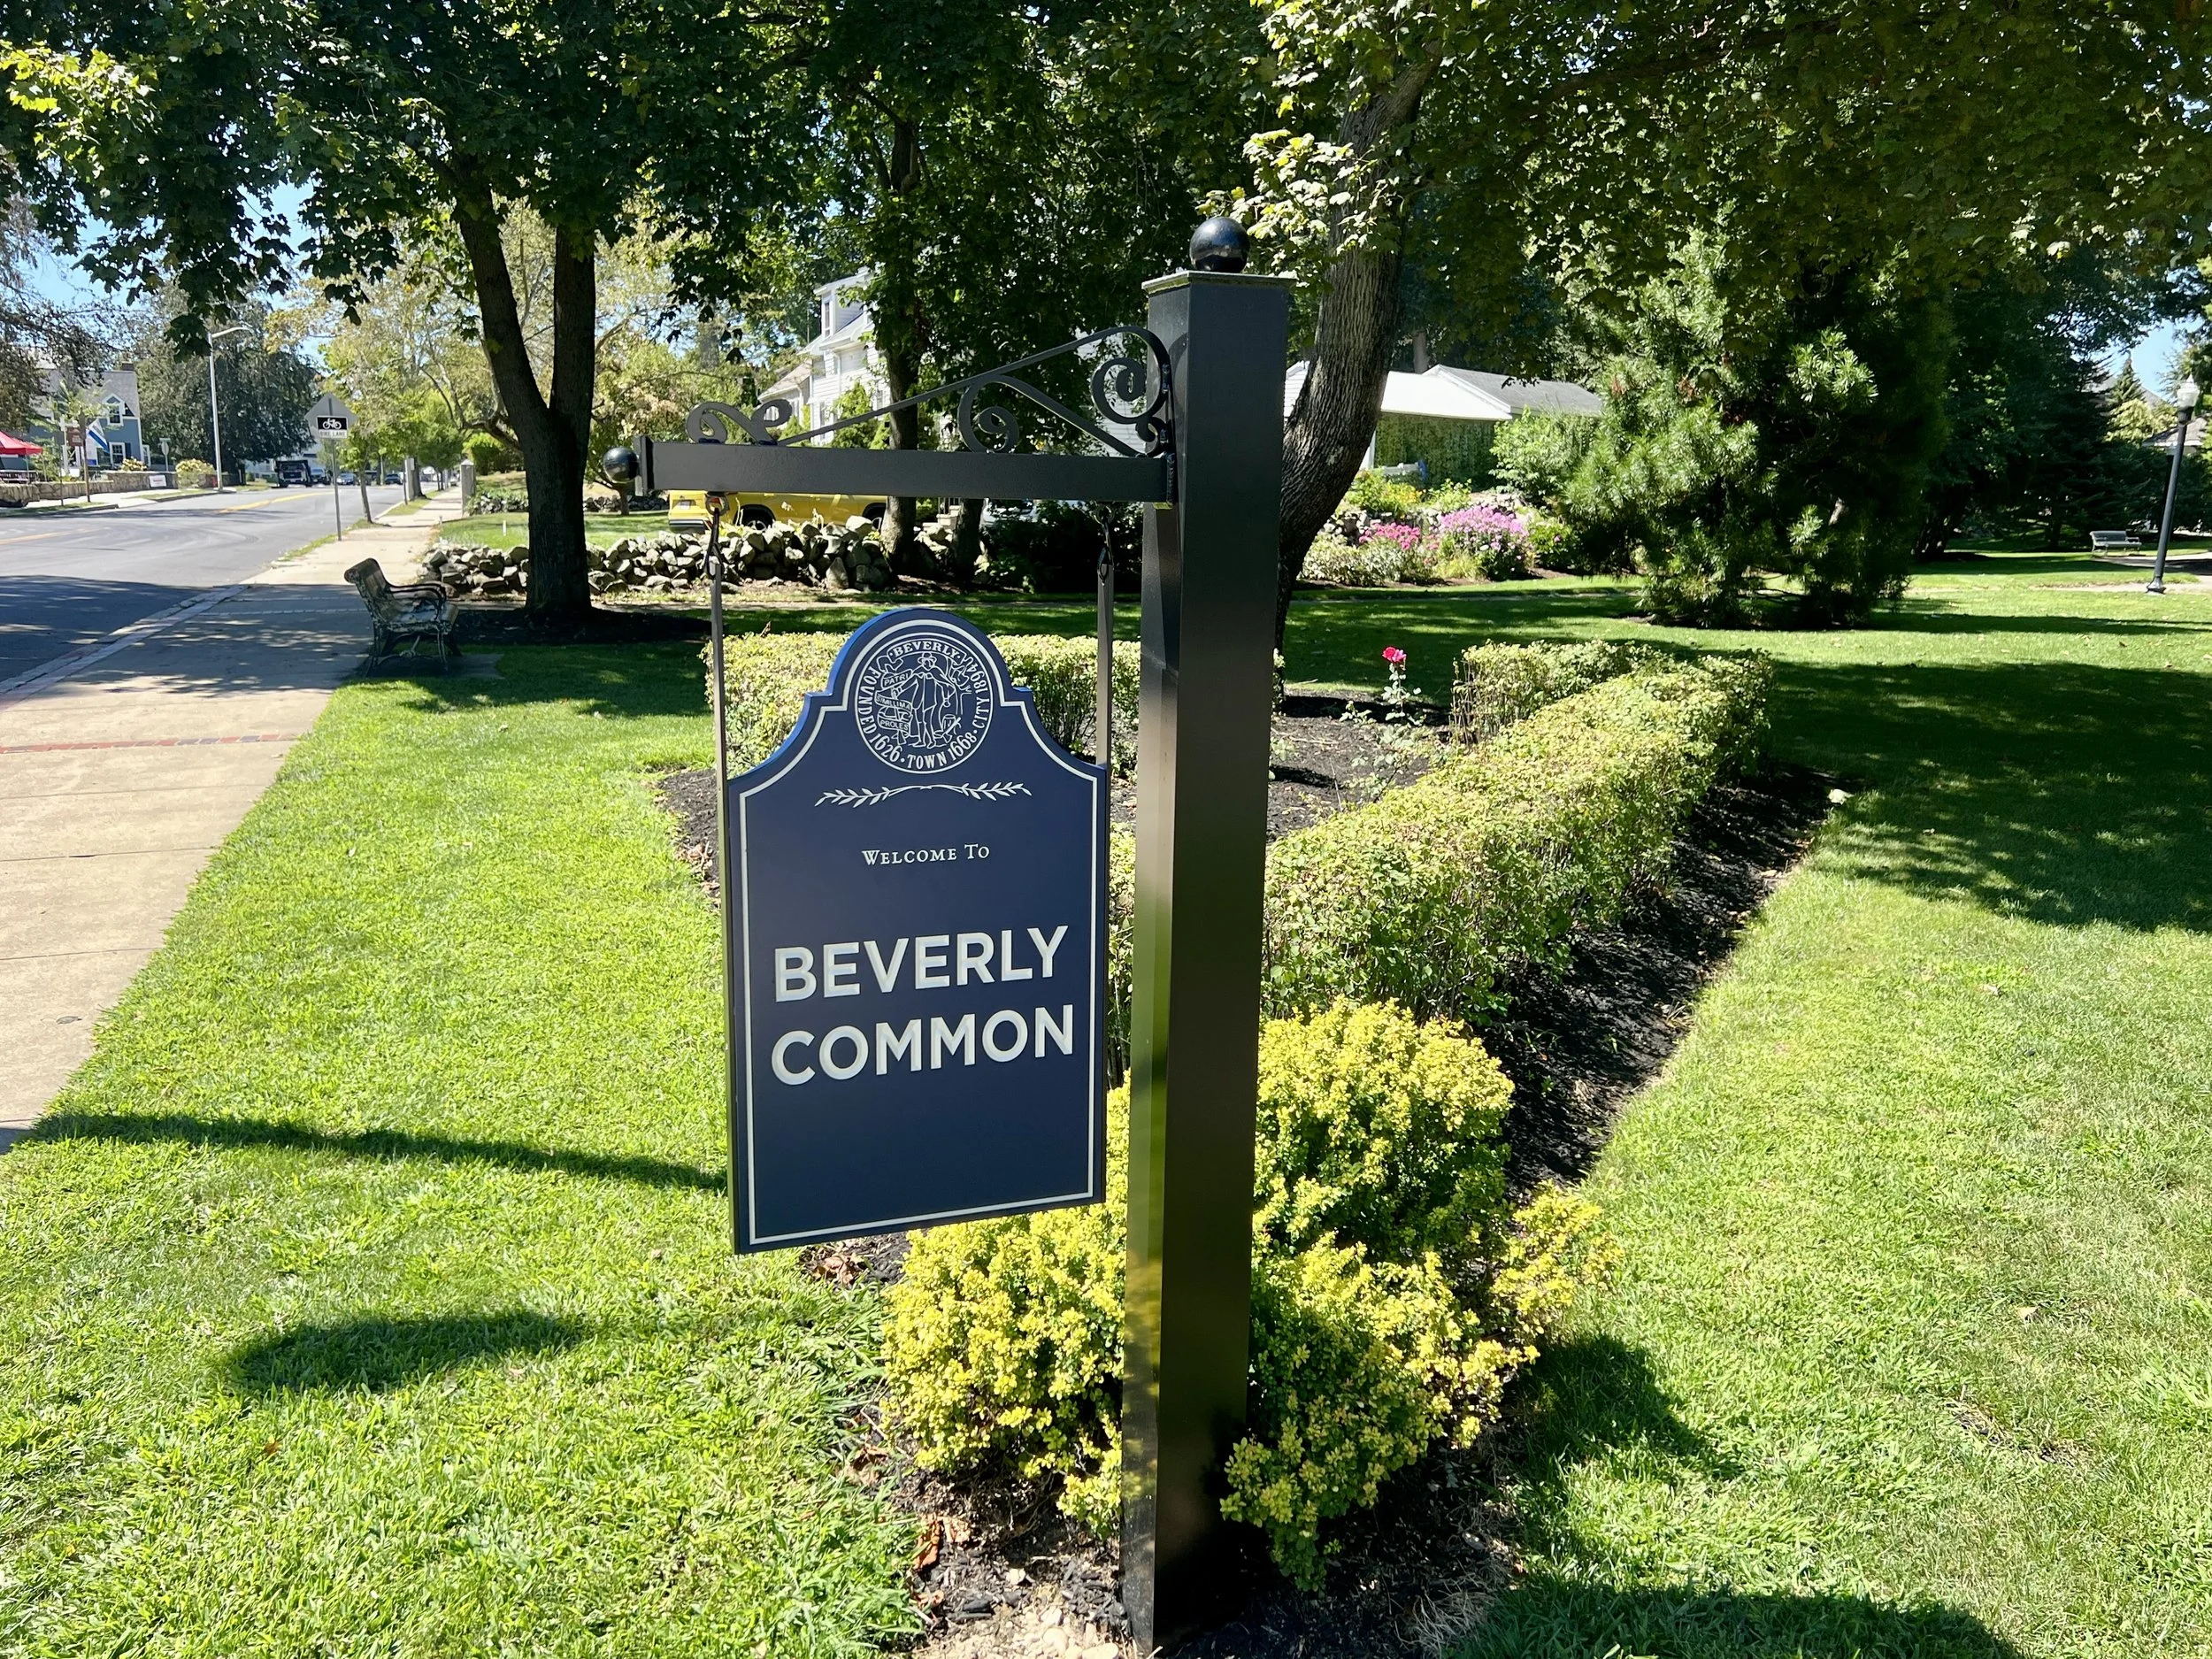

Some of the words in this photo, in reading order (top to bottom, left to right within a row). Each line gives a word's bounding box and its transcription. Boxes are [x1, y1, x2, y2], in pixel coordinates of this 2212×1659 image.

[894, 641, 958, 657] BEVERLY
[884, 672, 909, 687] PATRI
[966, 663, 988, 694] 1894
[875, 694, 910, 710] SIMILLIMA
[972, 697, 990, 729] CITY
[879, 719, 909, 732] PROLES
[869, 733, 902, 763] 1626
[907, 752, 948, 770] TOWN
[948, 732, 977, 761] 1668
[862, 847, 957, 866] WELCOME
[964, 842, 990, 860] TO
[774, 925, 1069, 1002] BEVERLY
[771, 1003, 1074, 1086] COMMON
